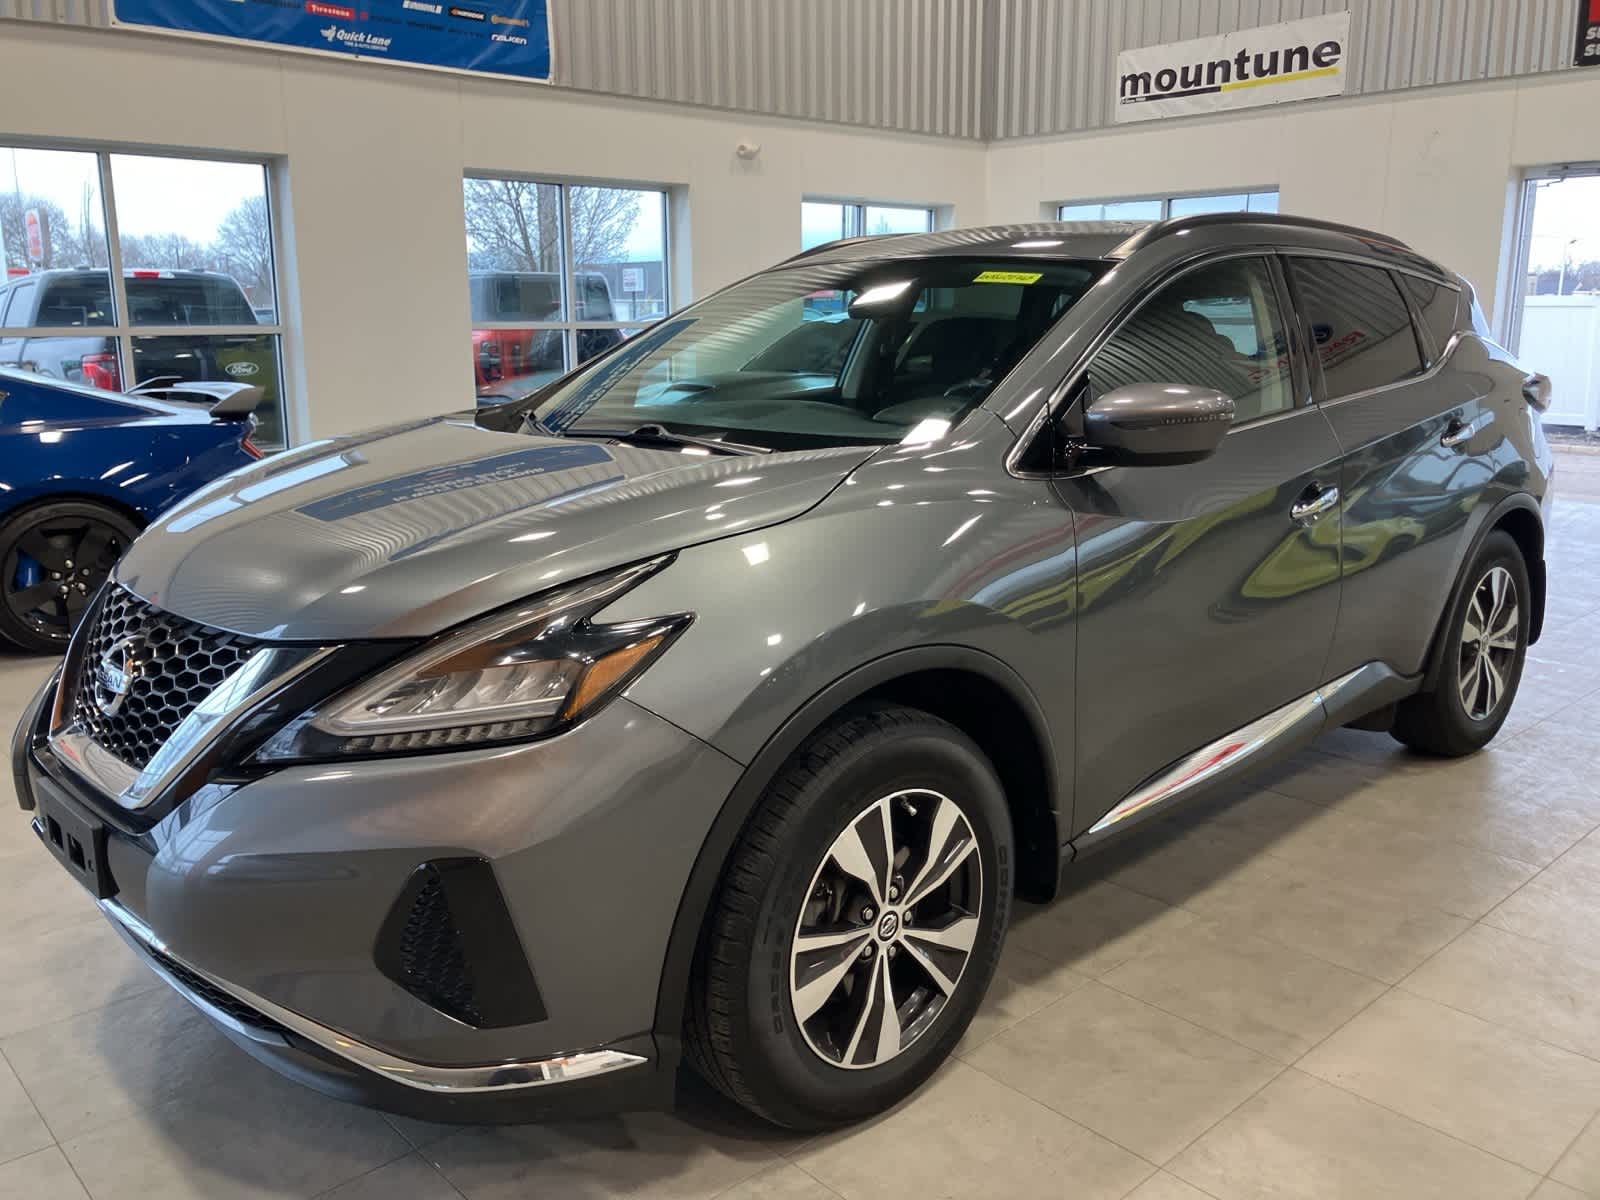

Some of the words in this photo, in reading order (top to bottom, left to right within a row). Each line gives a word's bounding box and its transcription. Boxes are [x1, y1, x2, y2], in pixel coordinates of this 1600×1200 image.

[311, 4, 350, 17] Firestone
[336, 29, 366, 43] Quick
[366, 34, 392, 47] Lane
[1120, 40, 1341, 97] mountune
